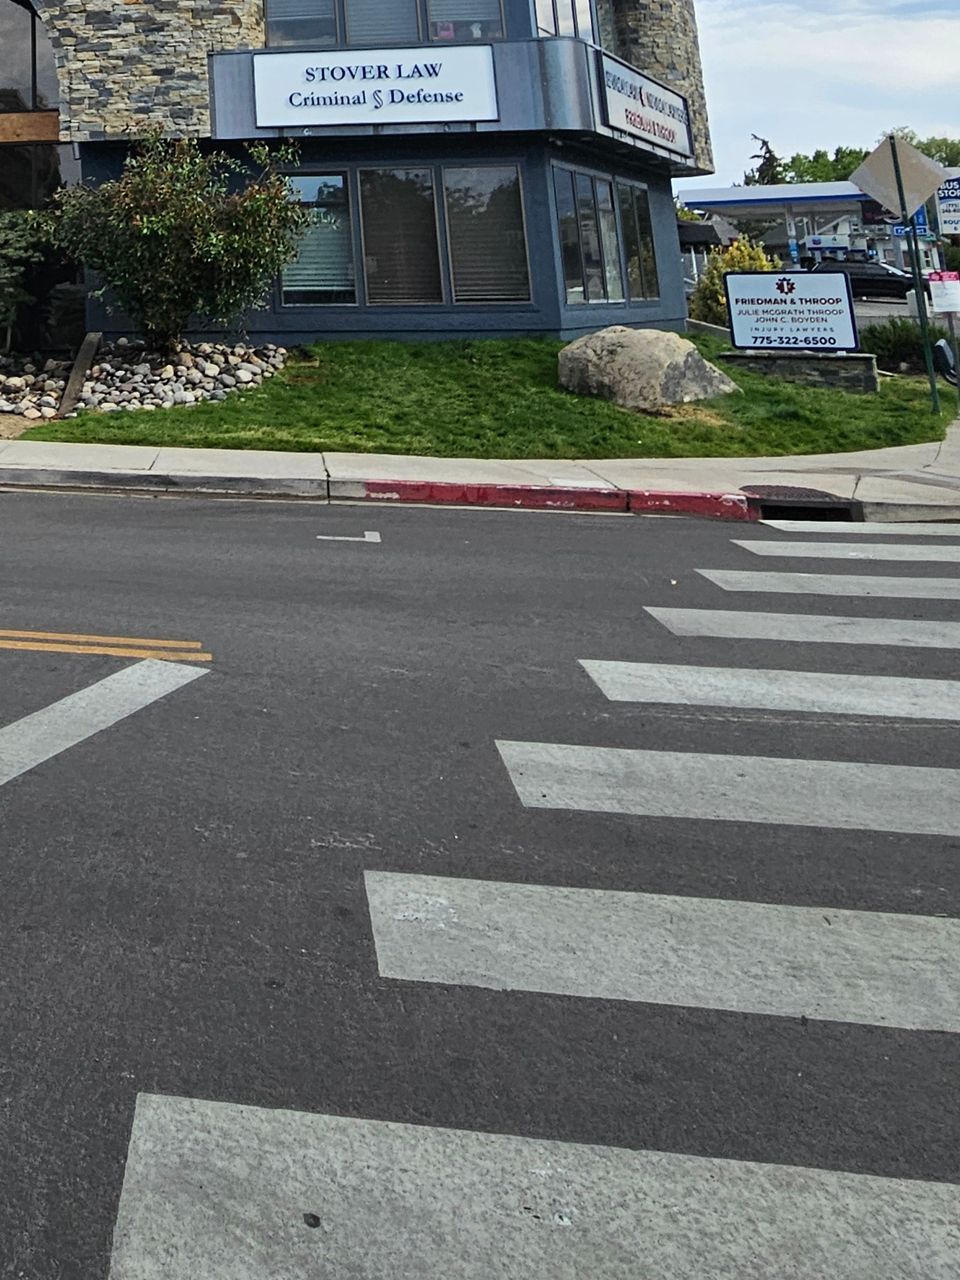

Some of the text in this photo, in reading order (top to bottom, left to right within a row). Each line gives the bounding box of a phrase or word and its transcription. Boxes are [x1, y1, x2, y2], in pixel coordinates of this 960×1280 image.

[305, 63, 443, 82] STOVER LAW
[289, 90, 367, 107] Criminal
[390, 88, 464, 105] Defense
[752, 336, 836, 345] 775-322-6500
